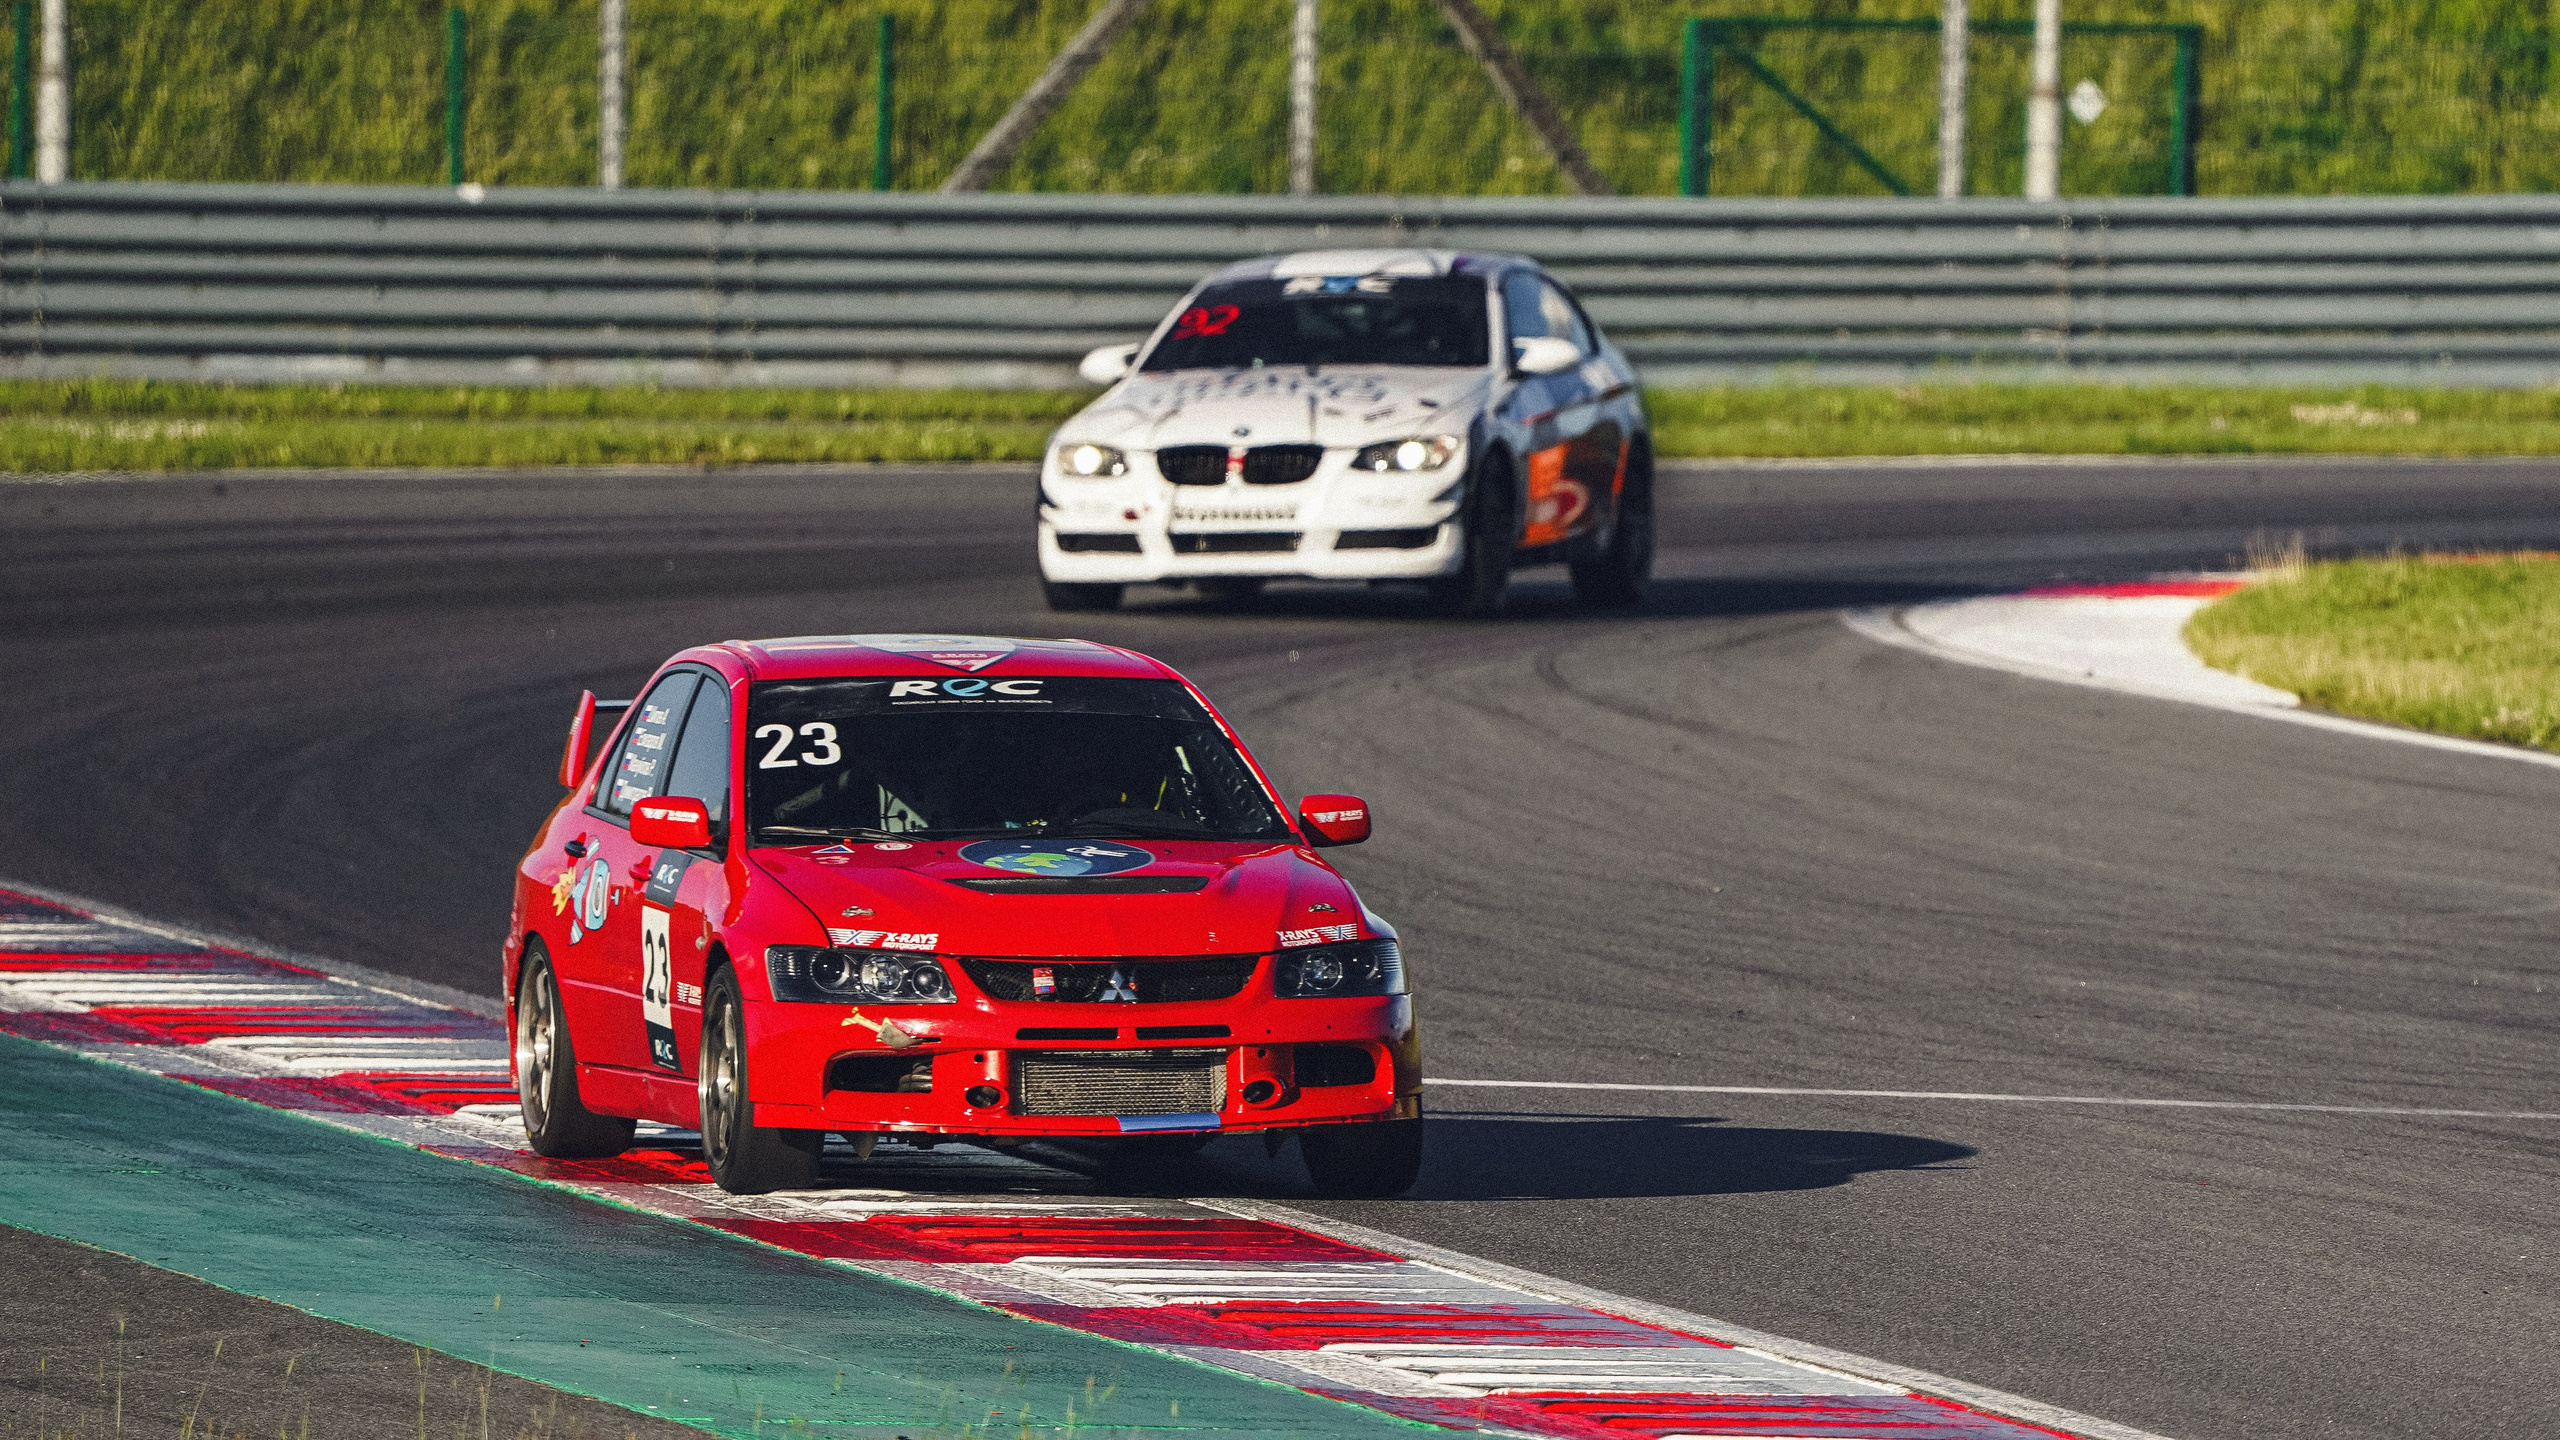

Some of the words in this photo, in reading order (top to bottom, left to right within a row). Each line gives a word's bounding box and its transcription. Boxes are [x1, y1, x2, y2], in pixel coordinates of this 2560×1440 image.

[1173, 304, 1241, 339] 92
[755, 722, 841, 769] 23
[881, 941, 937, 951] MOTORSPORT
[884, 932, 939, 944] X-RAYS
[1276, 928, 1319, 941] X-RAYS
[645, 929, 668, 1008] 23
